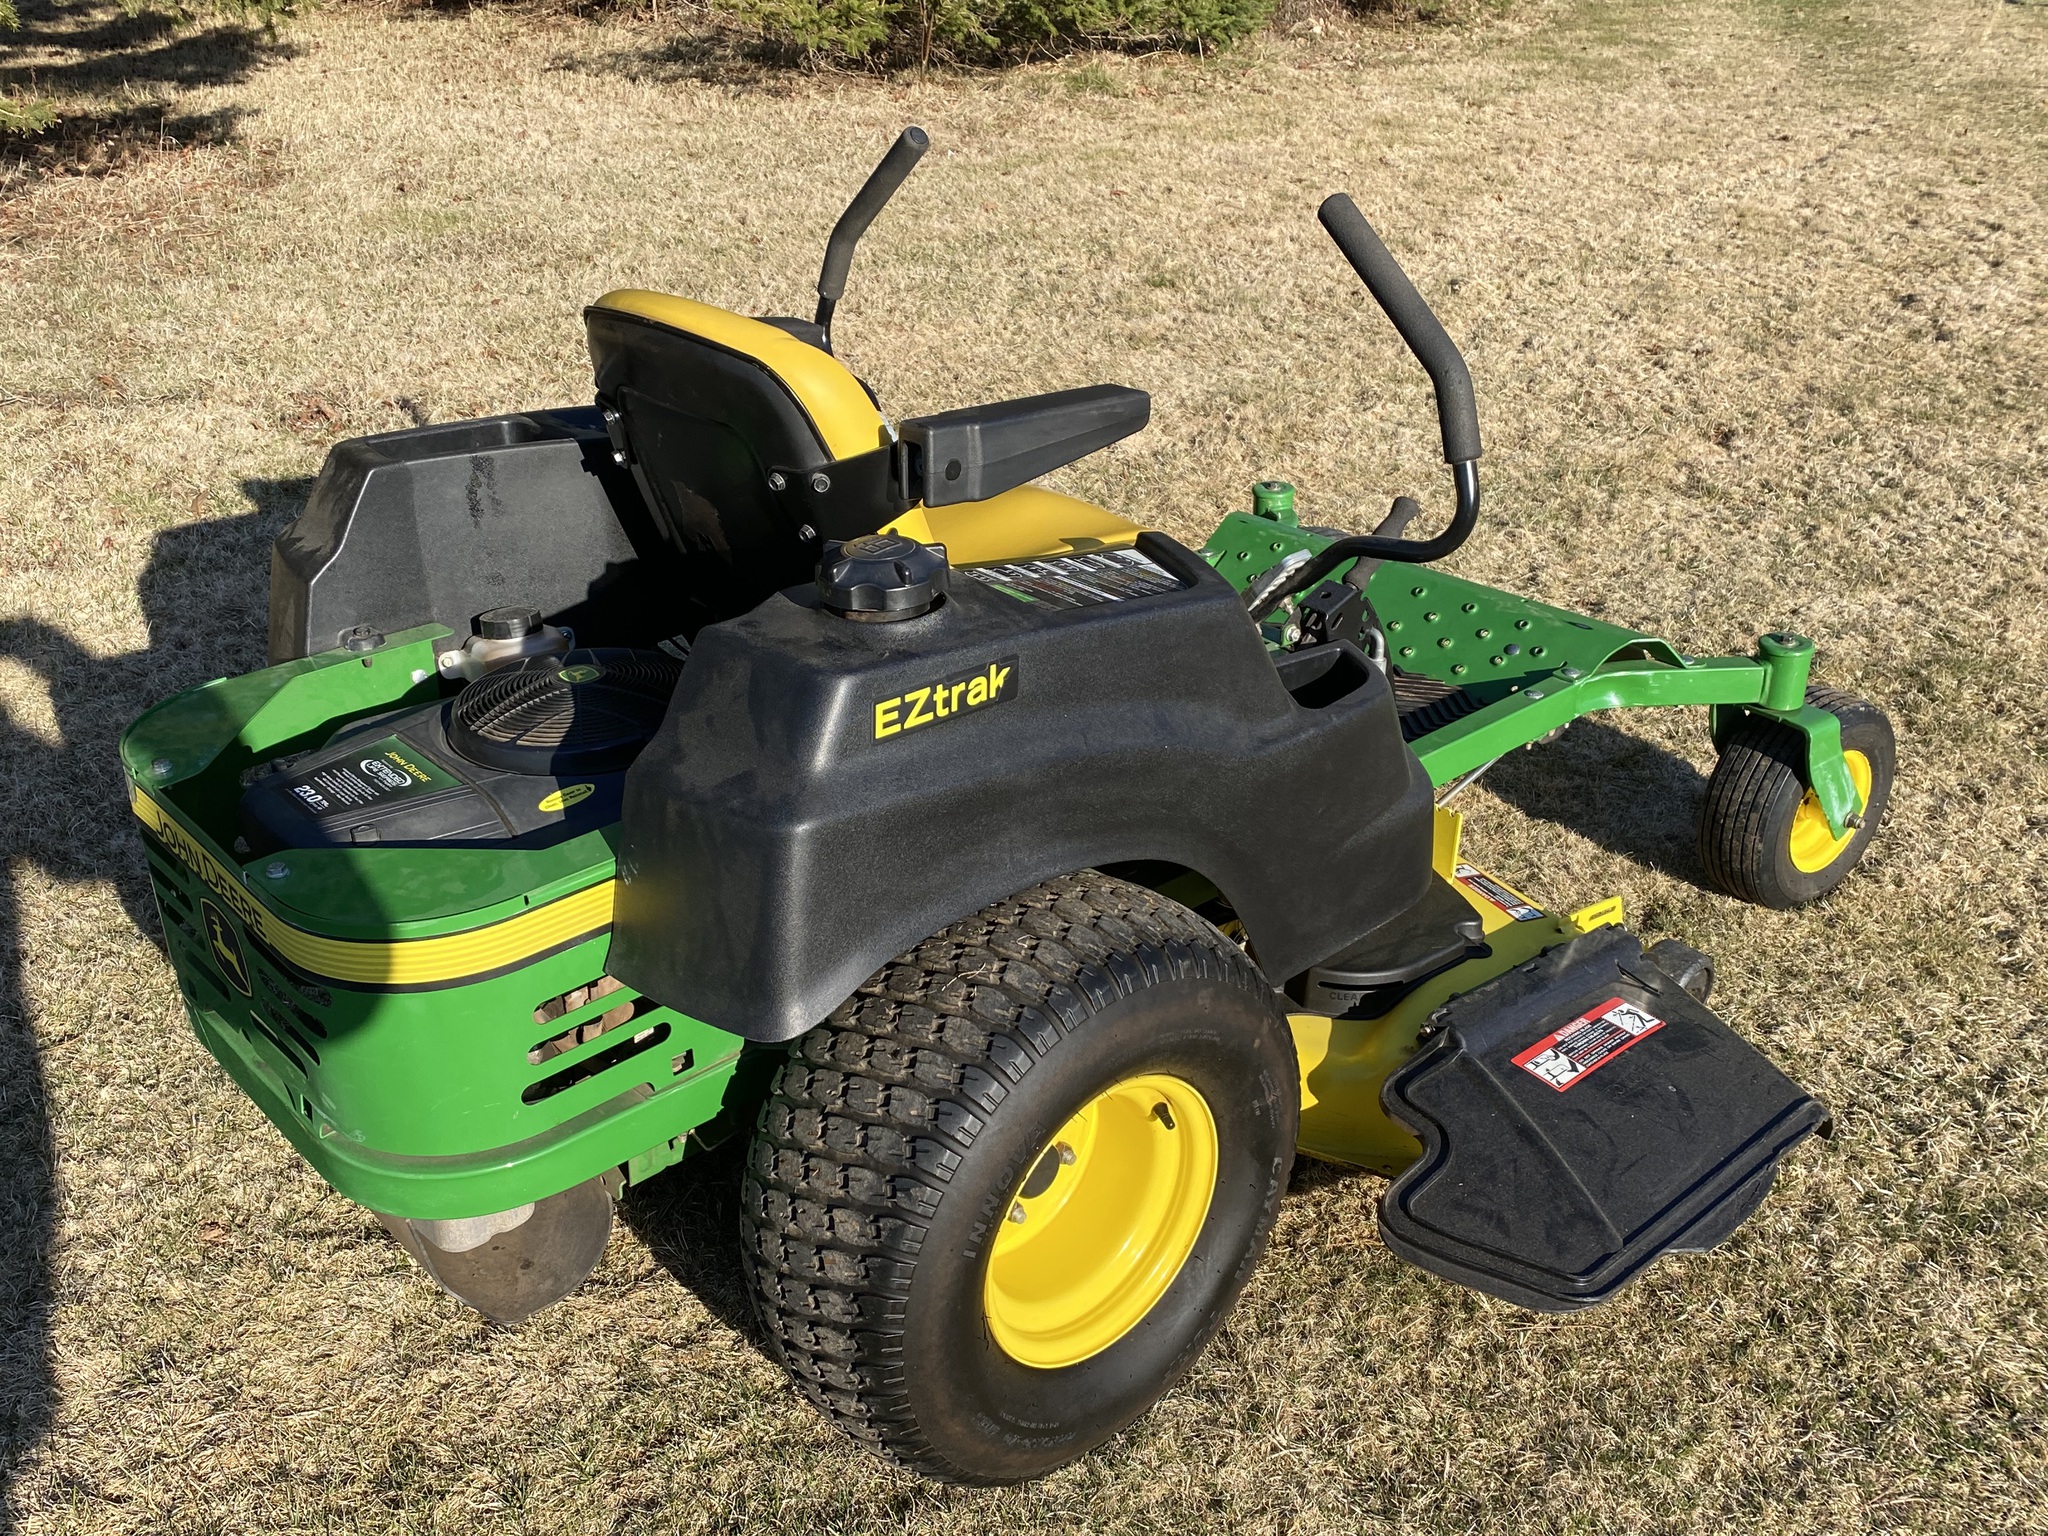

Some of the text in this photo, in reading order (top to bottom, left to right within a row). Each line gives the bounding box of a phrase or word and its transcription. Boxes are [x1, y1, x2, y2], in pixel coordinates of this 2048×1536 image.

[875, 664, 1011, 739] EZtrak
[371, 760, 406, 785] EXTENDED
[384, 751, 408, 766] JOHN
[403, 763, 432, 783] DEERE
[293, 784, 323, 803] 23.0
[156, 810, 269, 940] JOHN DEERE
[1329, 991, 1361, 1001] CLEA
[1558, 1016, 1592, 1038] DANGER
[962, 1123, 1046, 1259] INNOVA
[1234, 1156, 1283, 1281] CAYMAN
